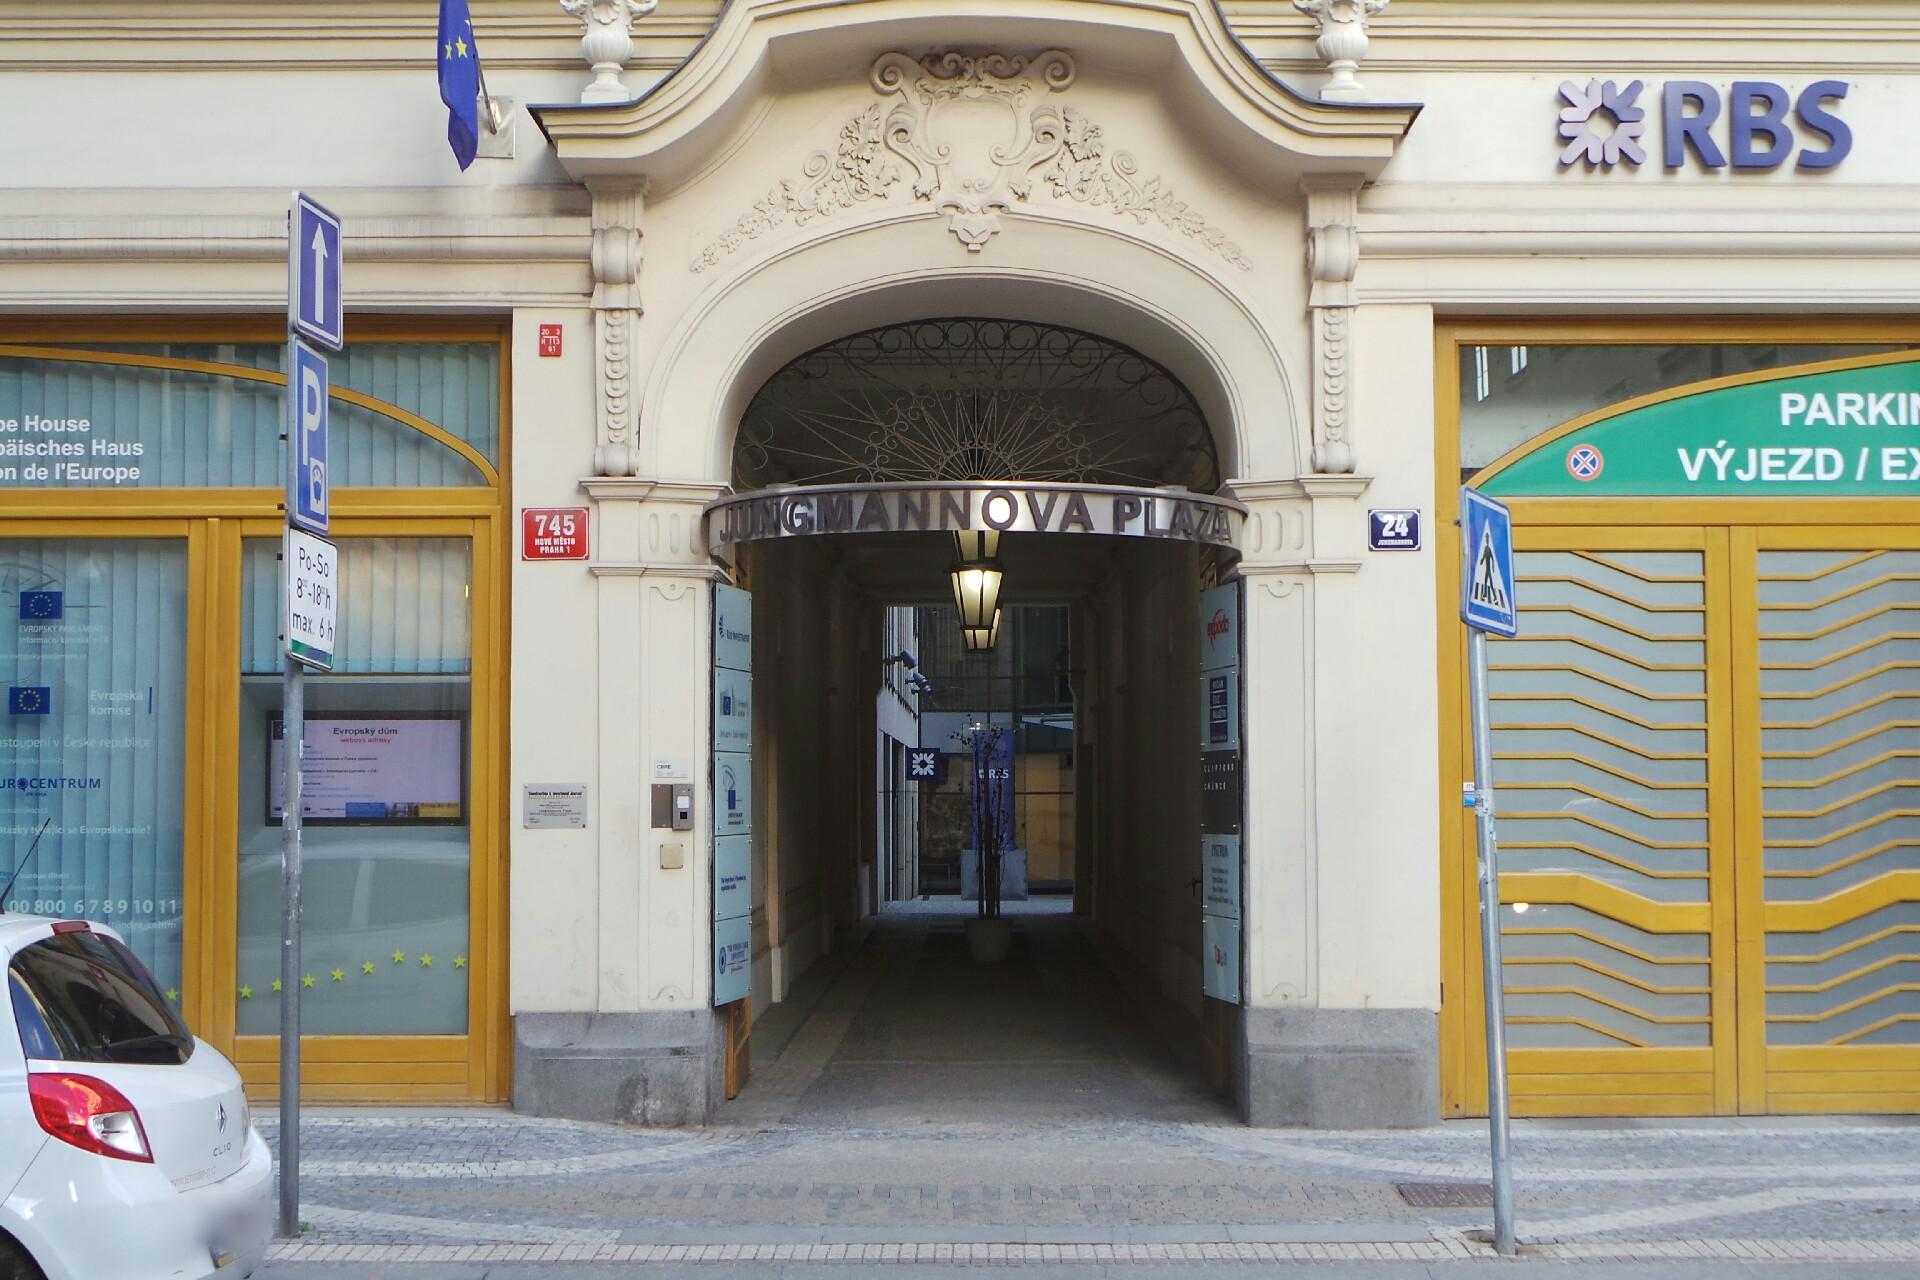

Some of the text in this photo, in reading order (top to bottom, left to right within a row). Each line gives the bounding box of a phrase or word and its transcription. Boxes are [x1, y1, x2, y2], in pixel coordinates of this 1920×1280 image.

[1663, 80, 1852, 168] RBS
[24, 415, 91, 432] House
[91, 440, 144, 456] Haus
[1678, 440, 1844, 481] VÝJEZD
[1855, 447, 1869, 481] /
[23, 463, 49, 481] de
[55, 463, 141, 483] l'Europe
[535, 514, 576, 536] 745
[719, 488, 1232, 543] JUNGMANNOVA PLAZA
[1382, 514, 1409, 537] 24
[534, 536, 576, 546] NOVÉ MĚSTO
[540, 546, 570, 554] PRAHA 1
[299, 547, 329, 578] Po-So
[292, 612, 333, 642] max. 6 h
[9, 900, 176, 914] 00 800 6 7 8 9 10 11
[212, 1142, 232, 1157] CLIO
